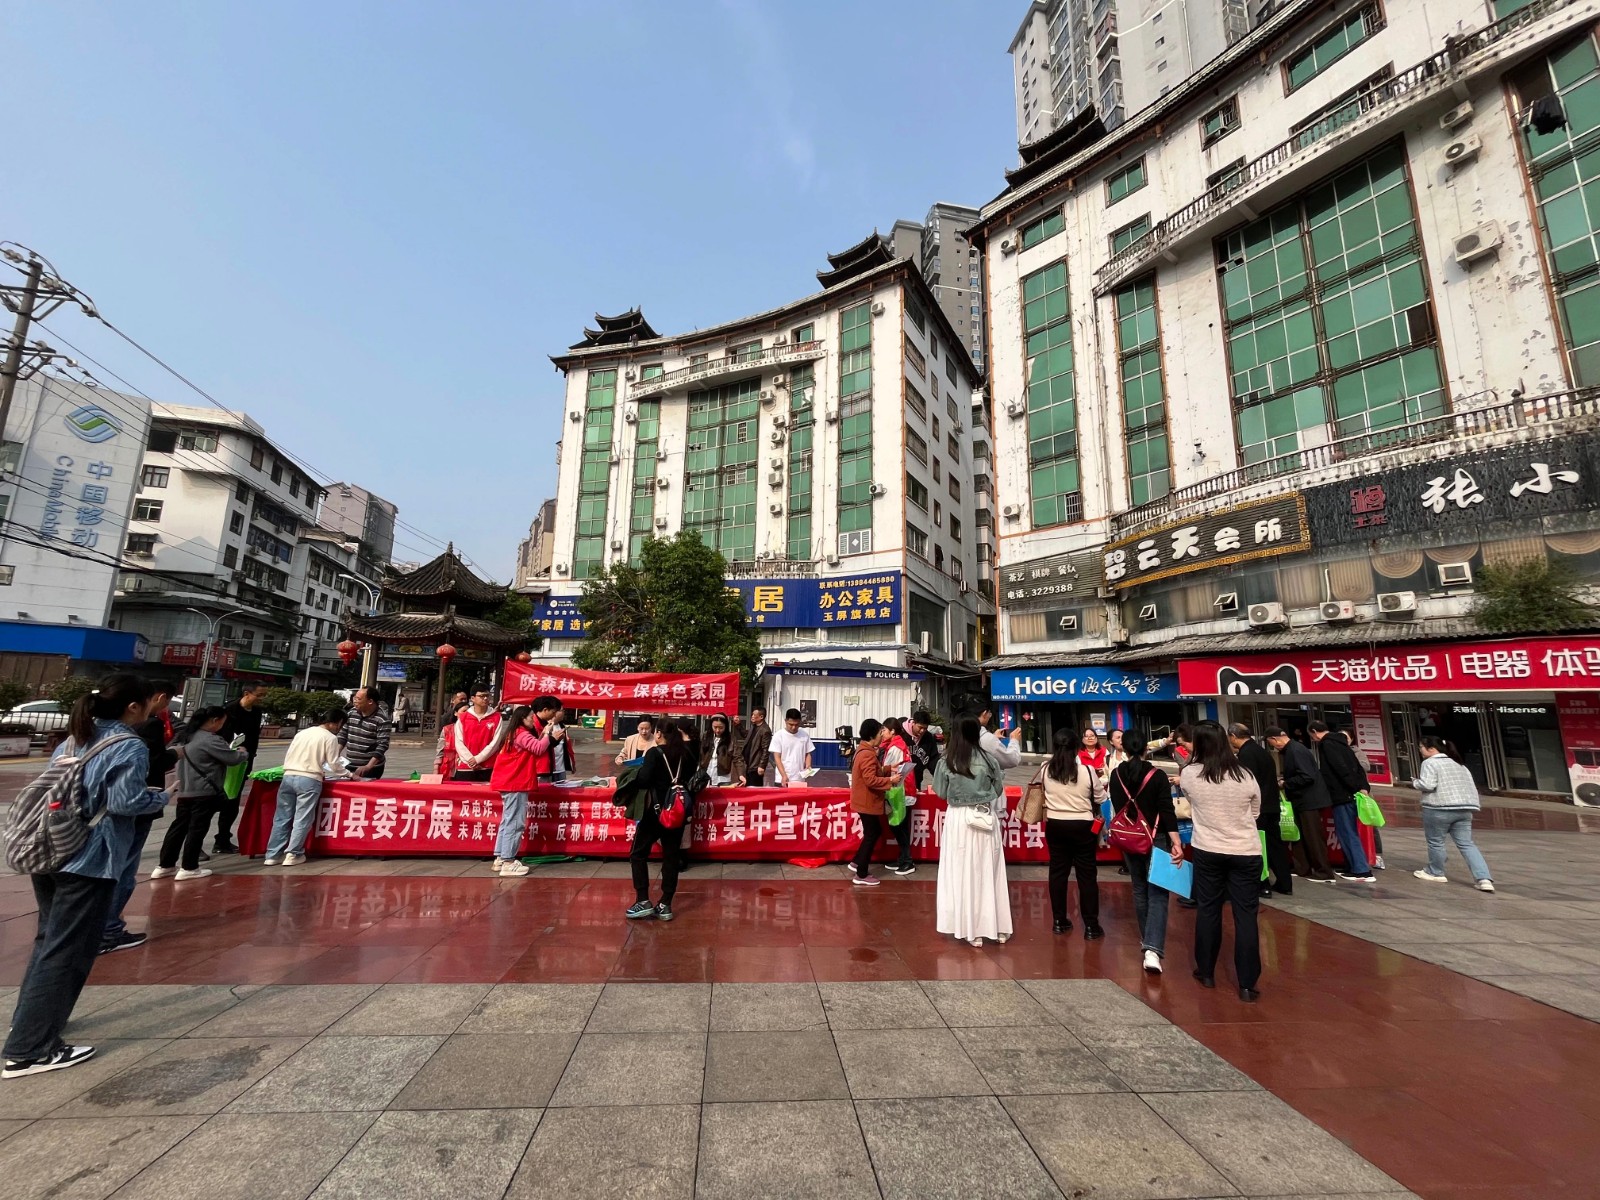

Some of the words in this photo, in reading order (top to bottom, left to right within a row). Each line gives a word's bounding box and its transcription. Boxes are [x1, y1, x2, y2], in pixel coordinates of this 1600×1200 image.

[48, 456, 74, 498] China
[71, 461, 113, 547] 中国移动
[1104, 517, 1282, 580] 碧云天会所
[819, 586, 894, 609] 办公家具
[822, 607, 891, 622] 玉屏旗舰店
[874, 671, 900, 679] POLICE
[1311, 655, 1438, 683] 天猫优品
[1014, 676, 1076, 695] Haier
[315, 797, 453, 840] 团县委开展
